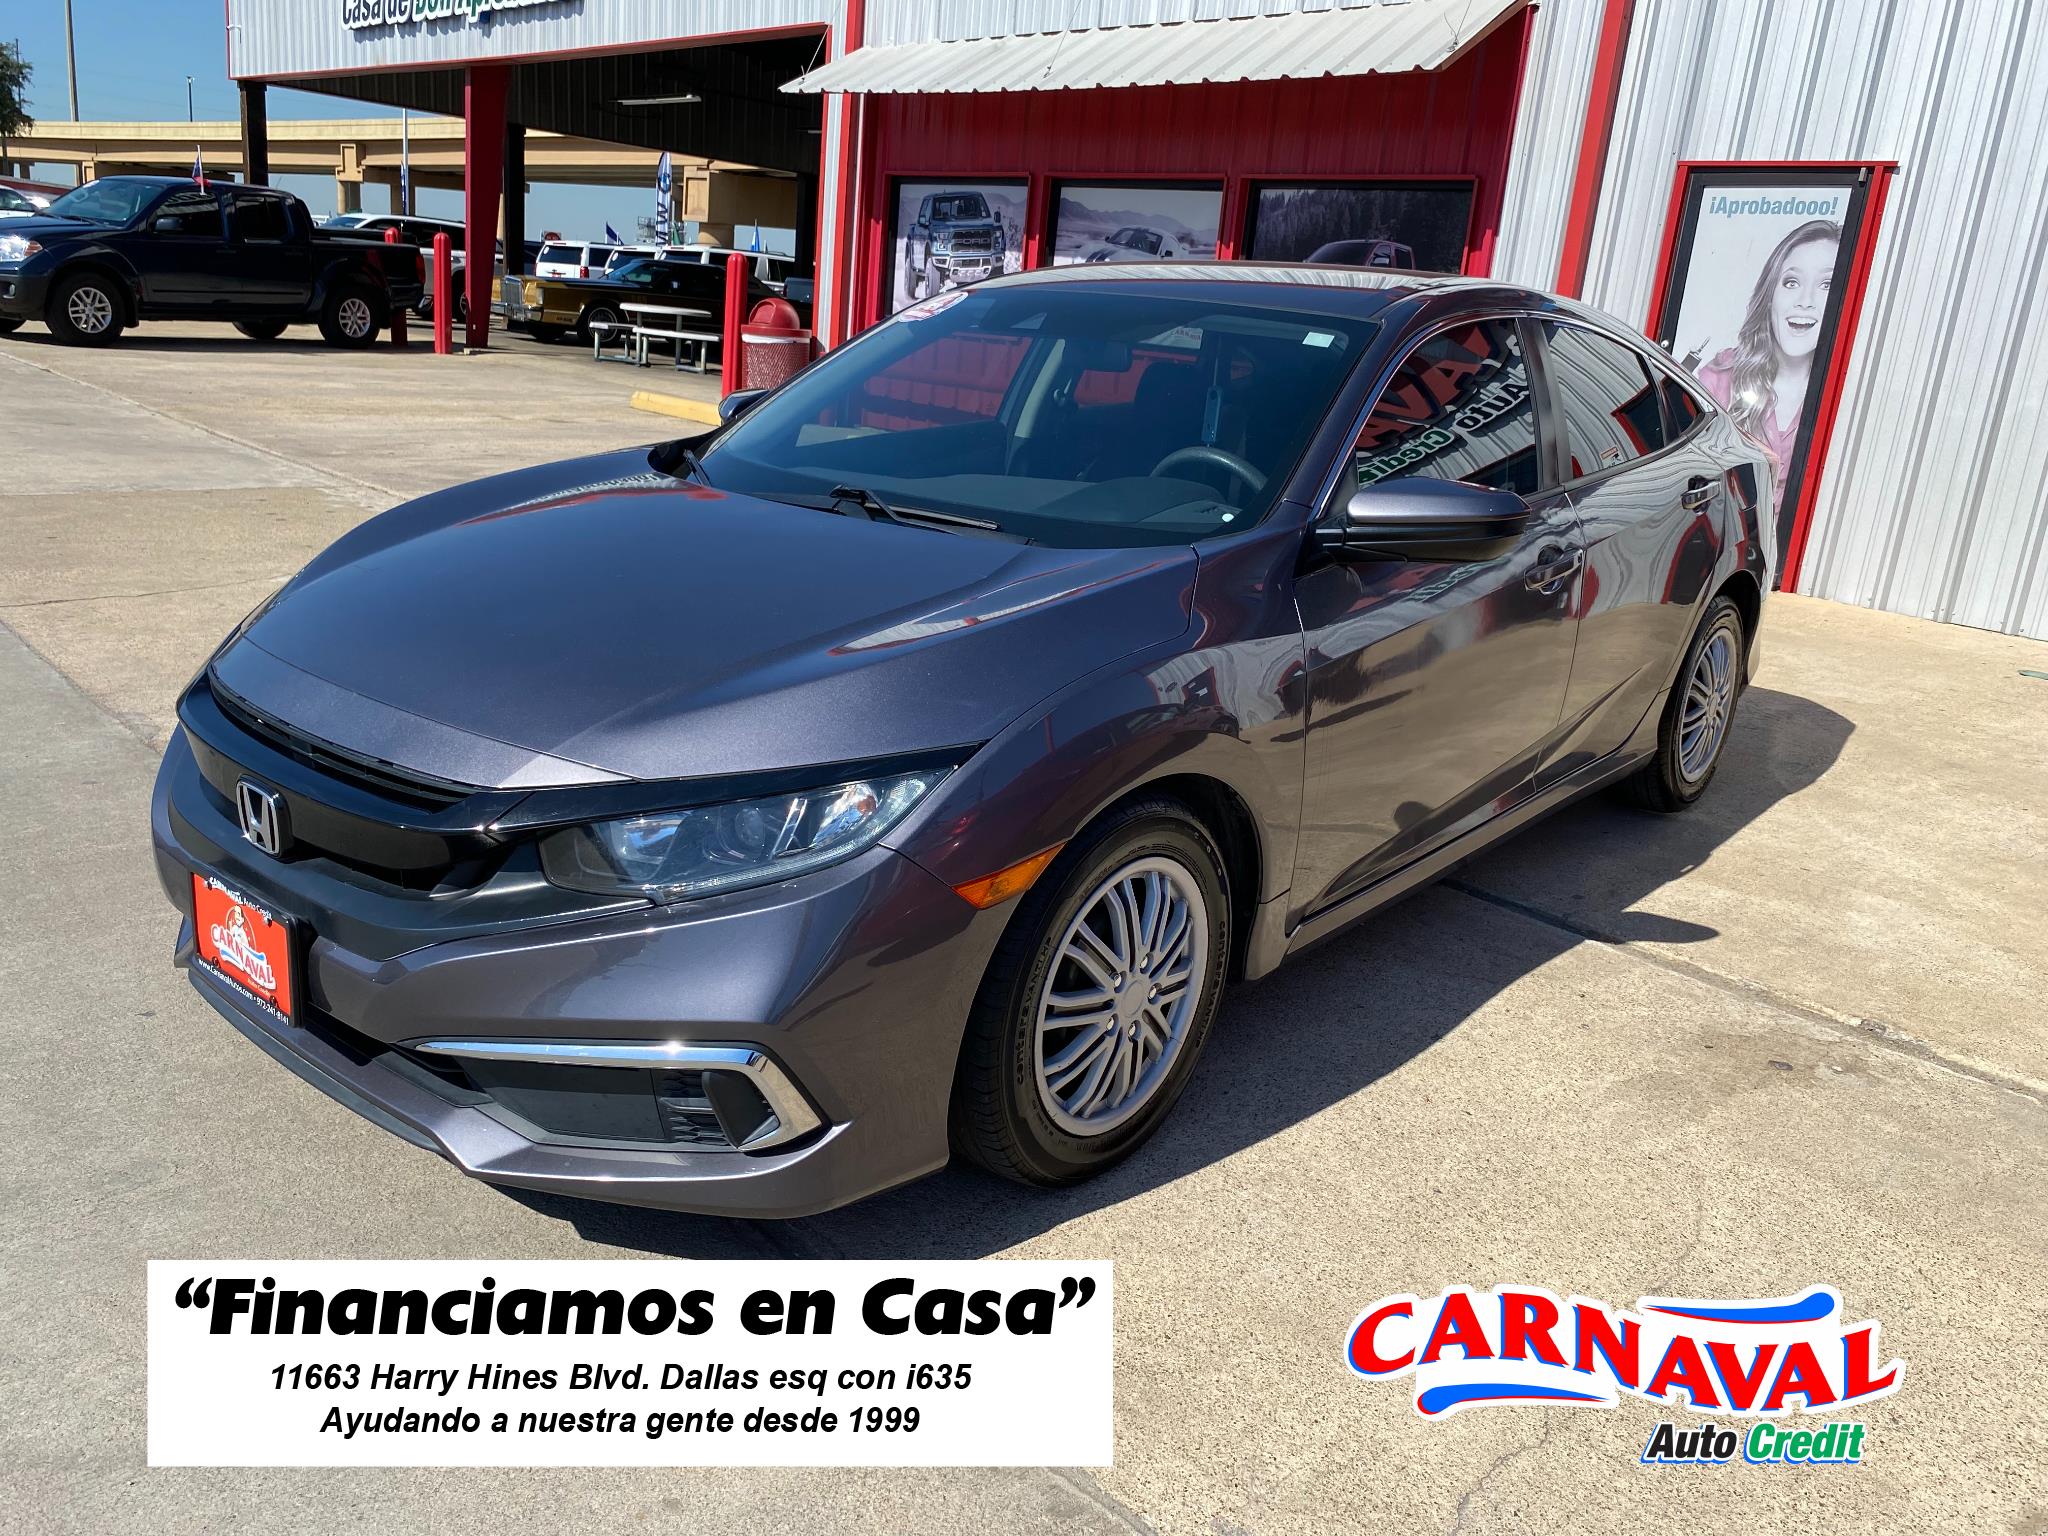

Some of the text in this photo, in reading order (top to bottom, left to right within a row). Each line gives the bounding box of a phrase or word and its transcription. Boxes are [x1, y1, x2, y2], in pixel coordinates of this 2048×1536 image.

[1709, 196, 1839, 218] ¡Aprobadooo!
[954, 237, 990, 245] FORD
[211, 925, 275, 984] CARNAVAL
